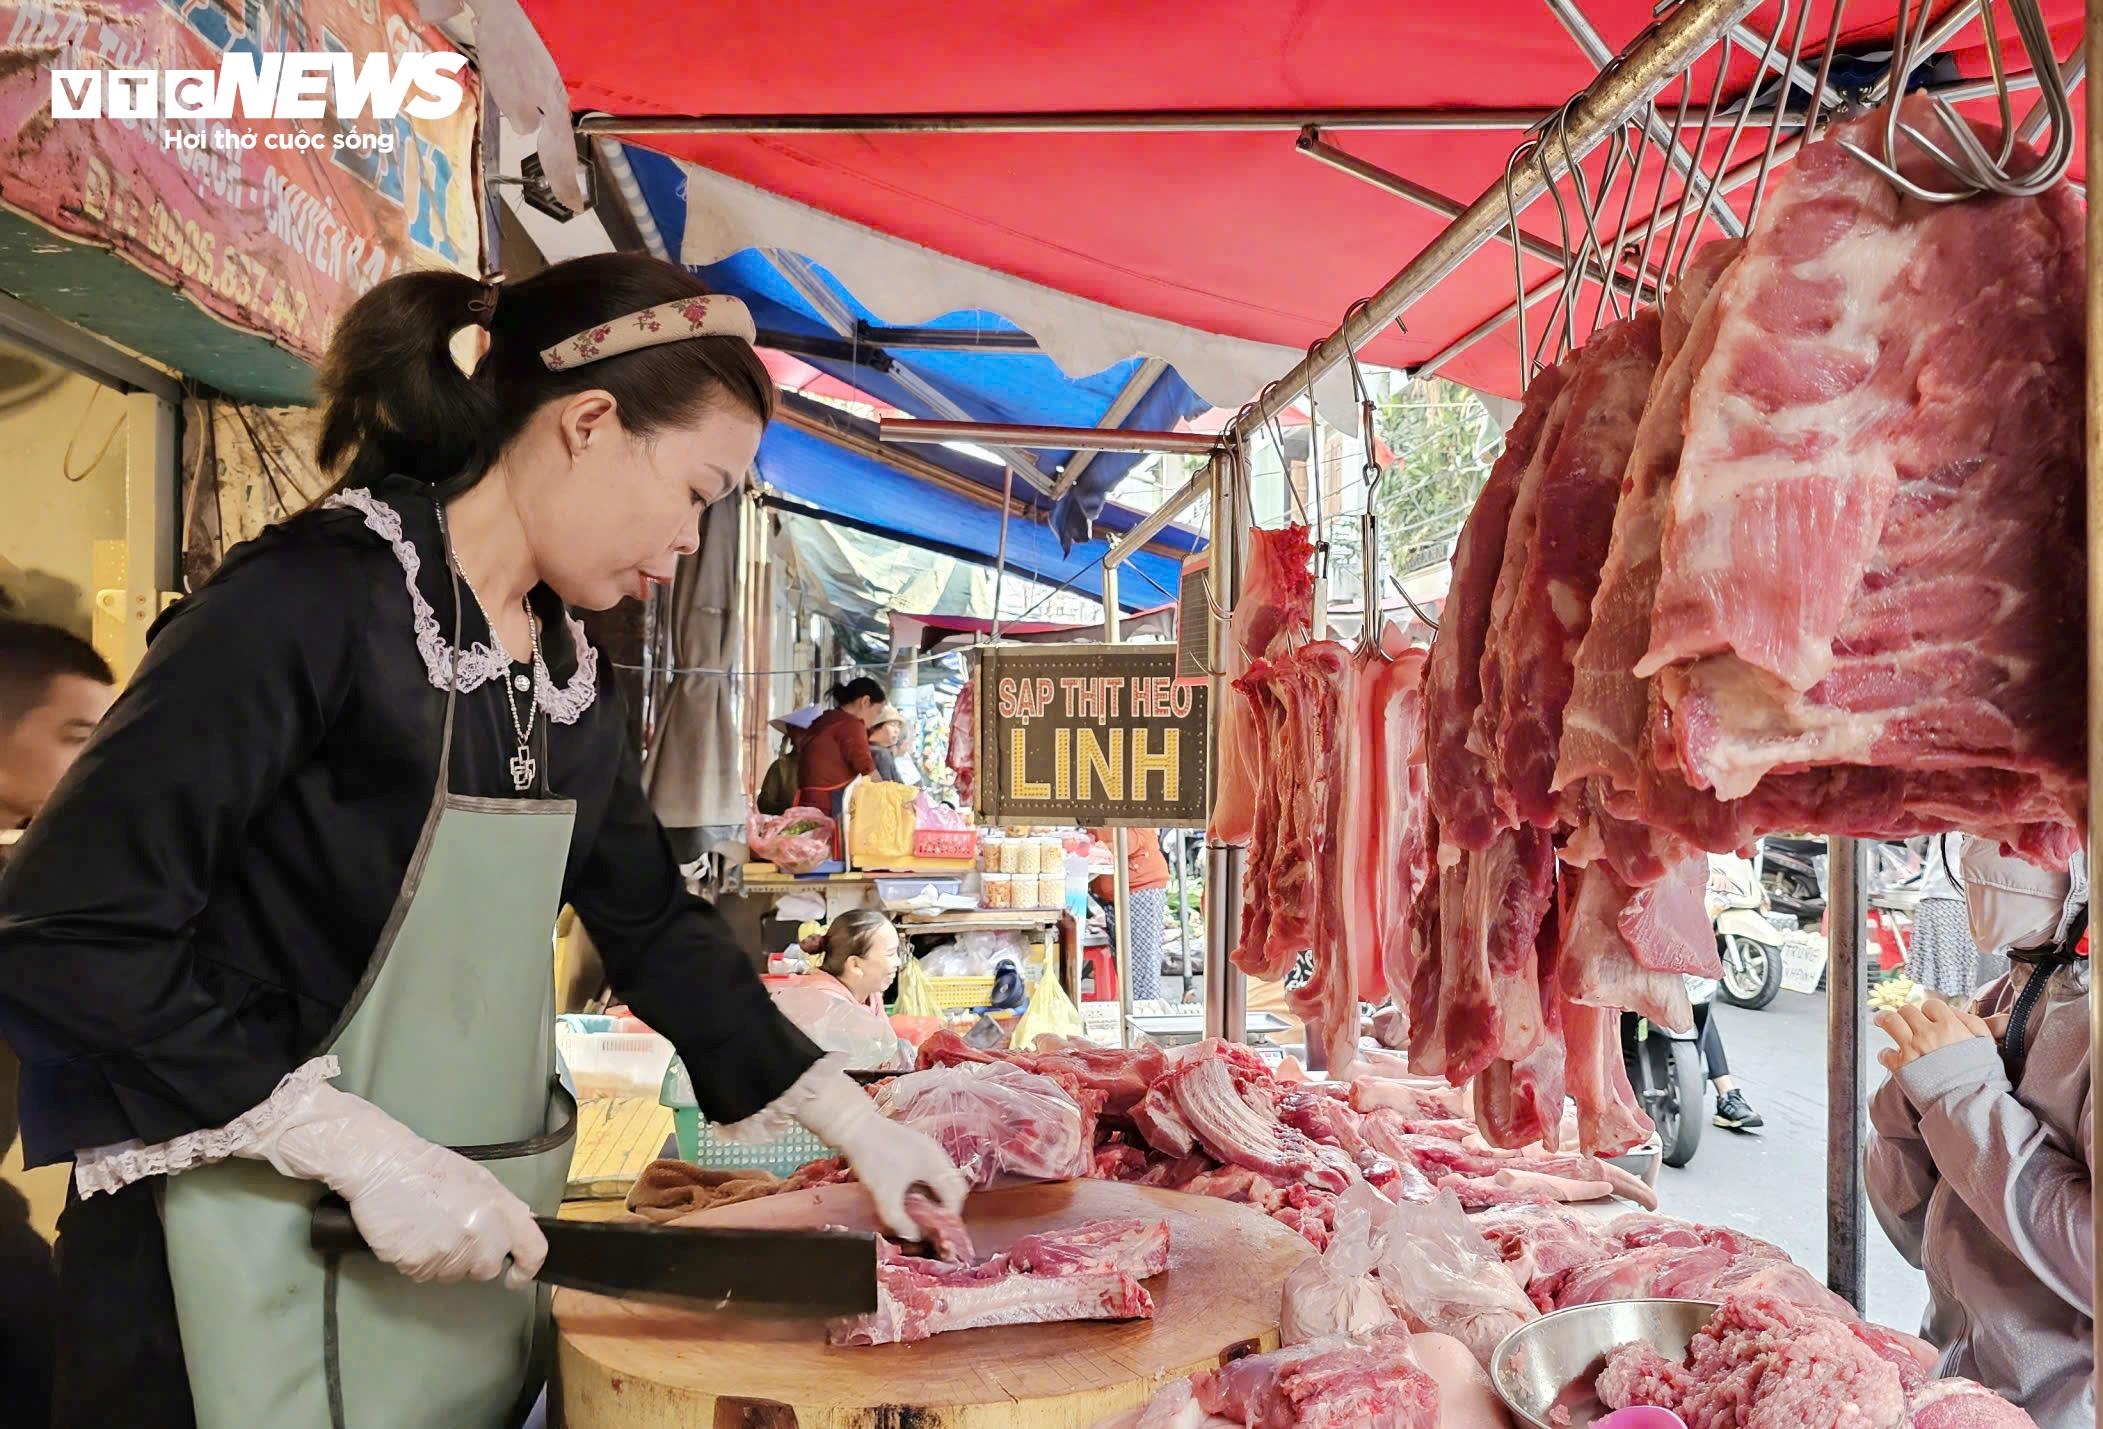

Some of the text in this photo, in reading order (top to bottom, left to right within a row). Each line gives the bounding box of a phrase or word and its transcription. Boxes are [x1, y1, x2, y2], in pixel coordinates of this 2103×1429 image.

[999, 676, 1193, 726] SẠP THỊT HEO
[1010, 727, 1180, 802] LINH
